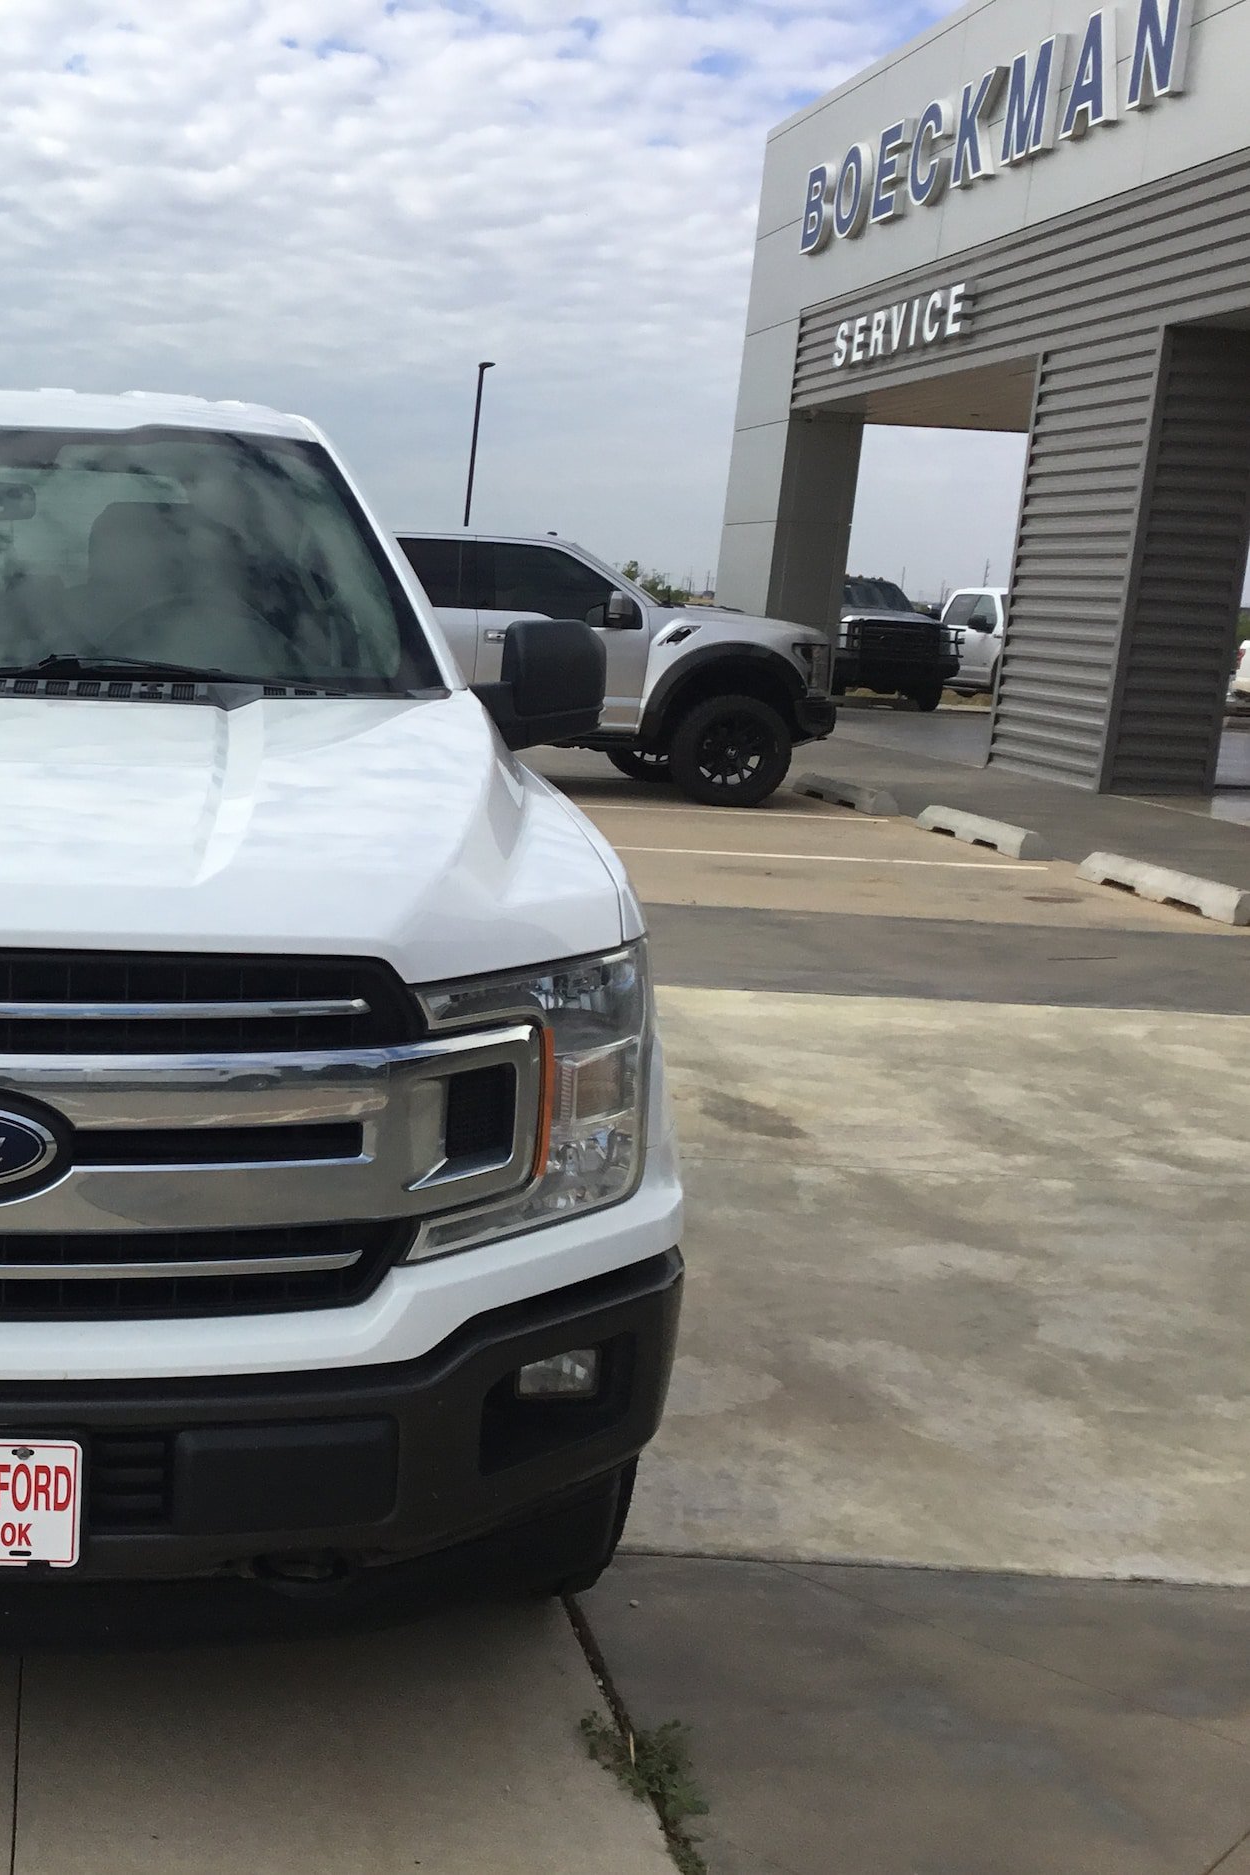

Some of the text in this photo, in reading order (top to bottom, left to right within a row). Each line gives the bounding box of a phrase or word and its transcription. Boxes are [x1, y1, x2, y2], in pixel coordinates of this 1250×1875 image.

[799, 0, 1186, 255] BOECKMAN
[832, 282, 968, 368] SERVICE
[0, 1522, 33, 1547] OK
